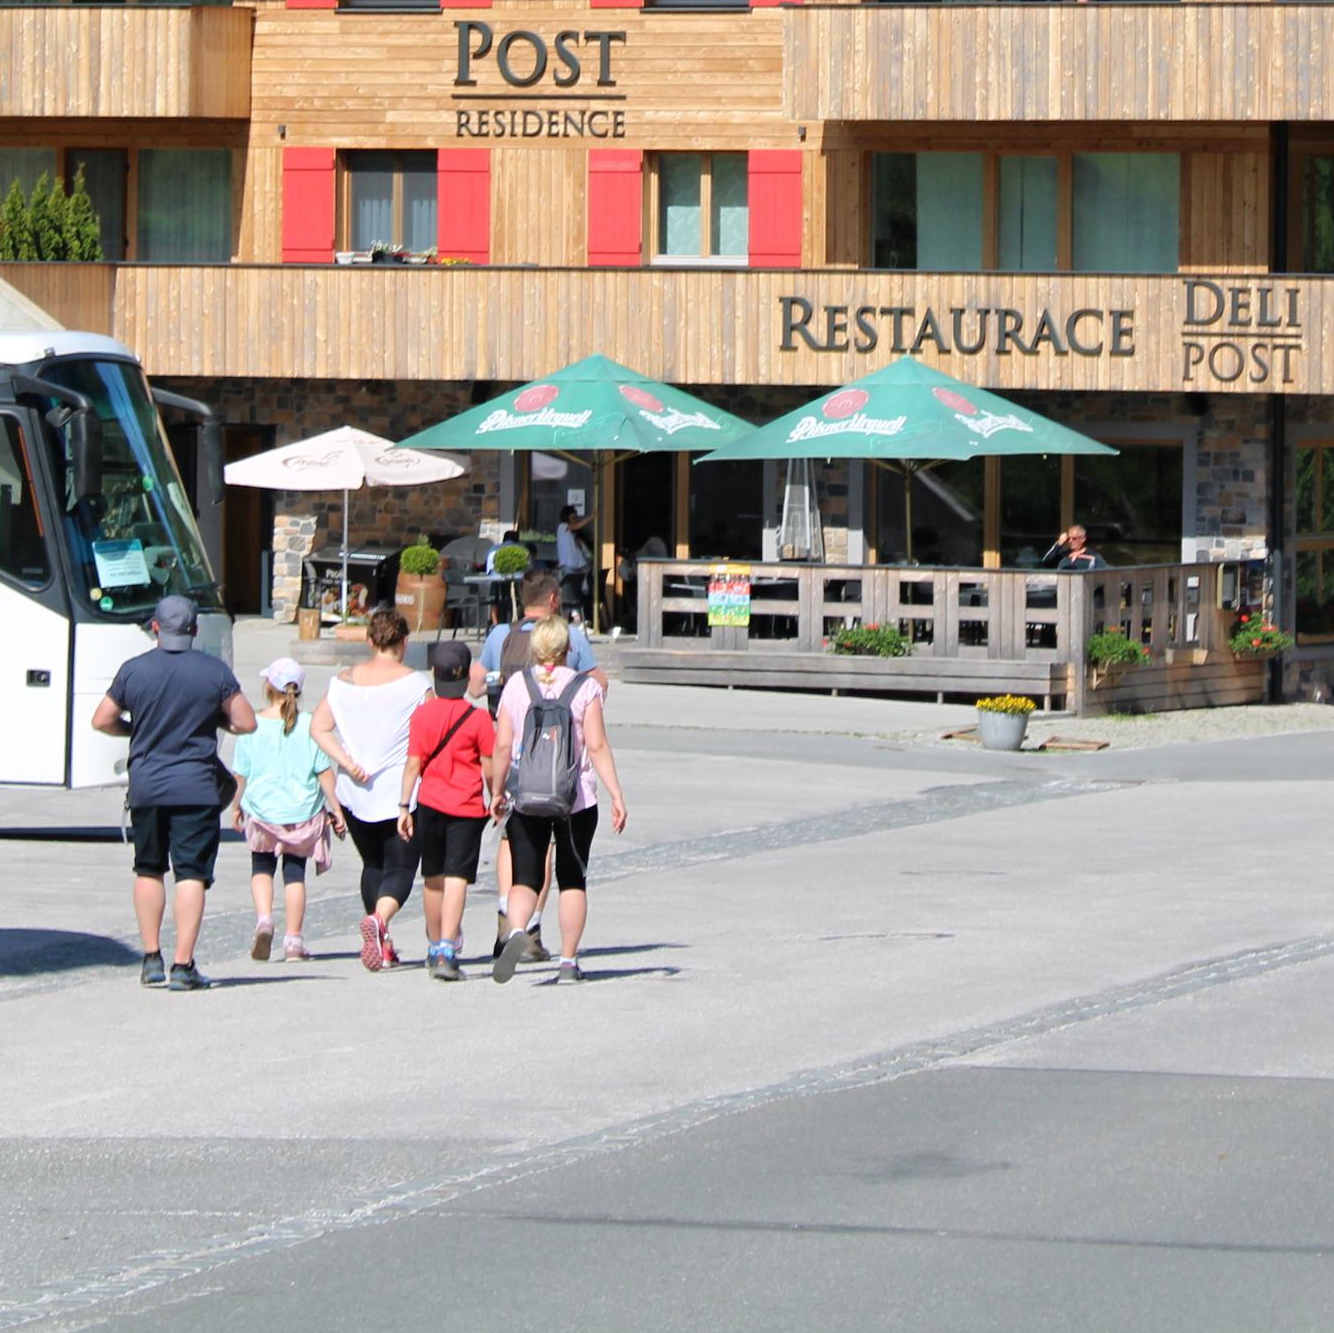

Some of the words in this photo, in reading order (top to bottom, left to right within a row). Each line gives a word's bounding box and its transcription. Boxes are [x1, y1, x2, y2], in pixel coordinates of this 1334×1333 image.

[453, 20, 627, 88] POST
[455, 110, 627, 139] RESIDENCE
[779, 296, 1137, 357] RESTAURACE
[1182, 280, 1302, 328] DELI
[1182, 341, 1302, 384] POST
